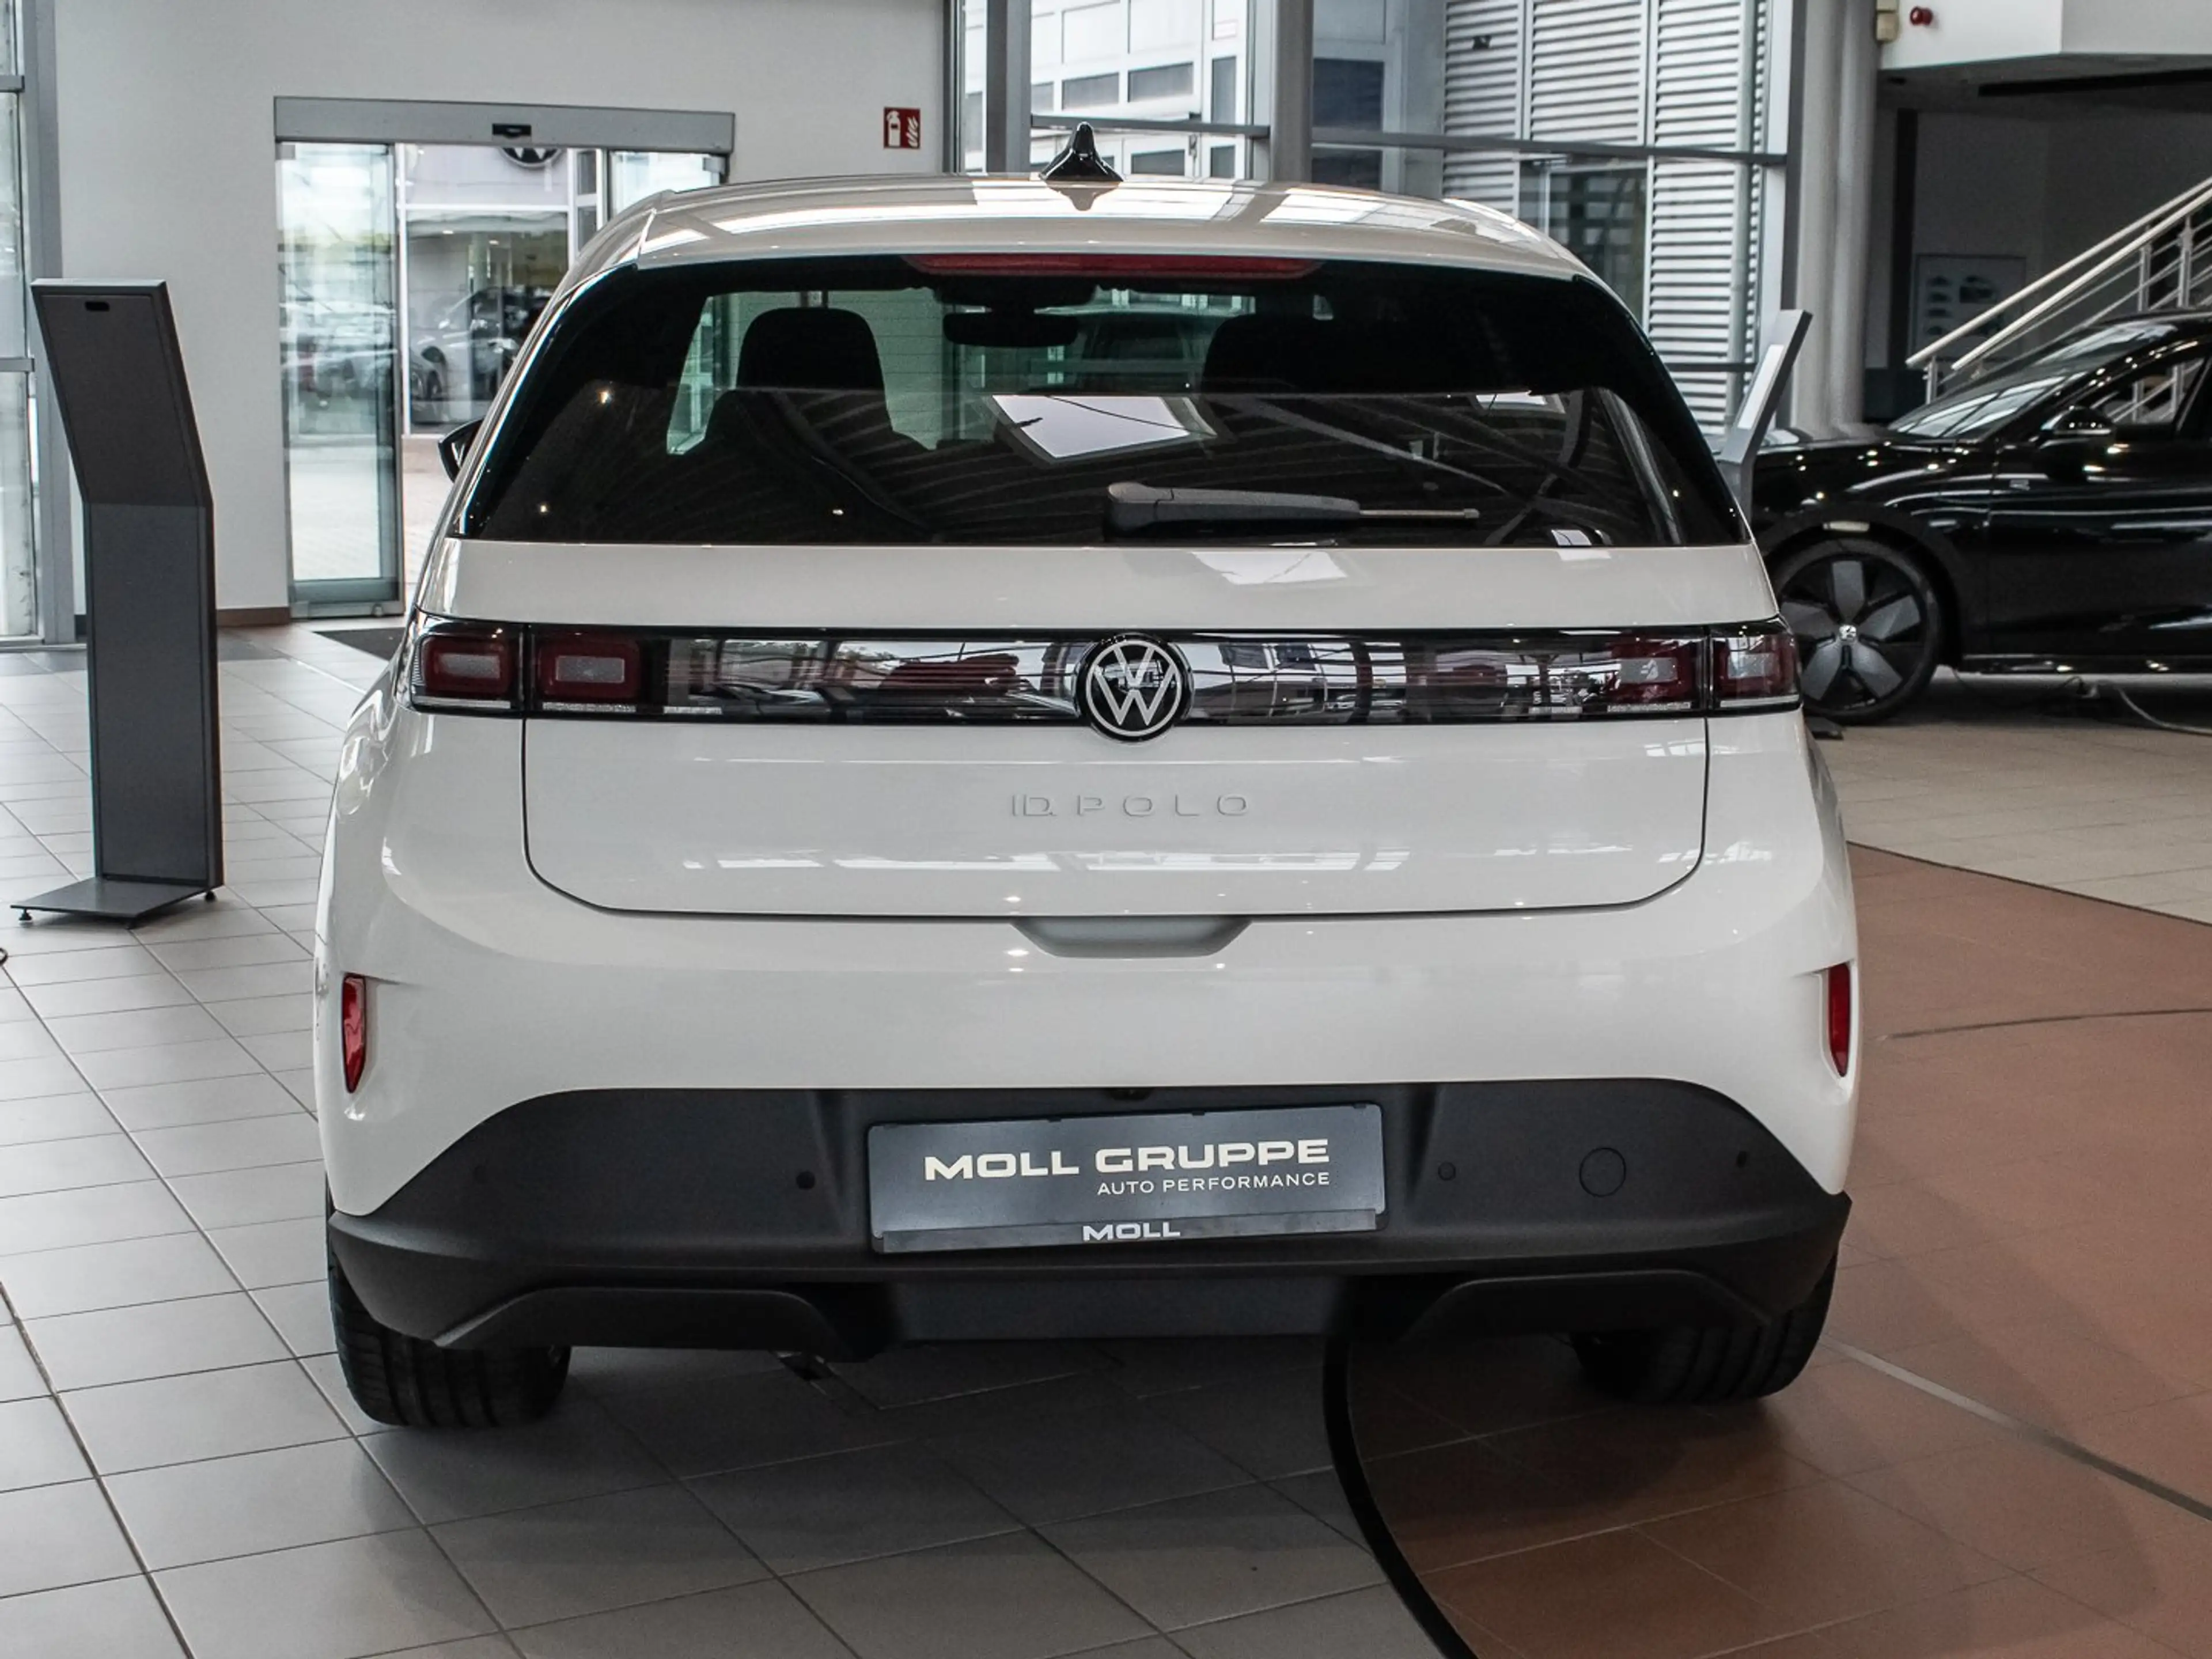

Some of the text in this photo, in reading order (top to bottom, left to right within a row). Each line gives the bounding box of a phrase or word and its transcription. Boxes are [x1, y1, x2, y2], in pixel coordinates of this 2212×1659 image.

[1089, 642, 1179, 732] VW
[1075, 793, 1249, 818] POLO
[924, 1138, 1330, 1181] MOLL GRUPPE
[1096, 1171, 1330, 1196] AUTO PERFORMANCE
[1082, 1221, 1181, 1242] MOLL
